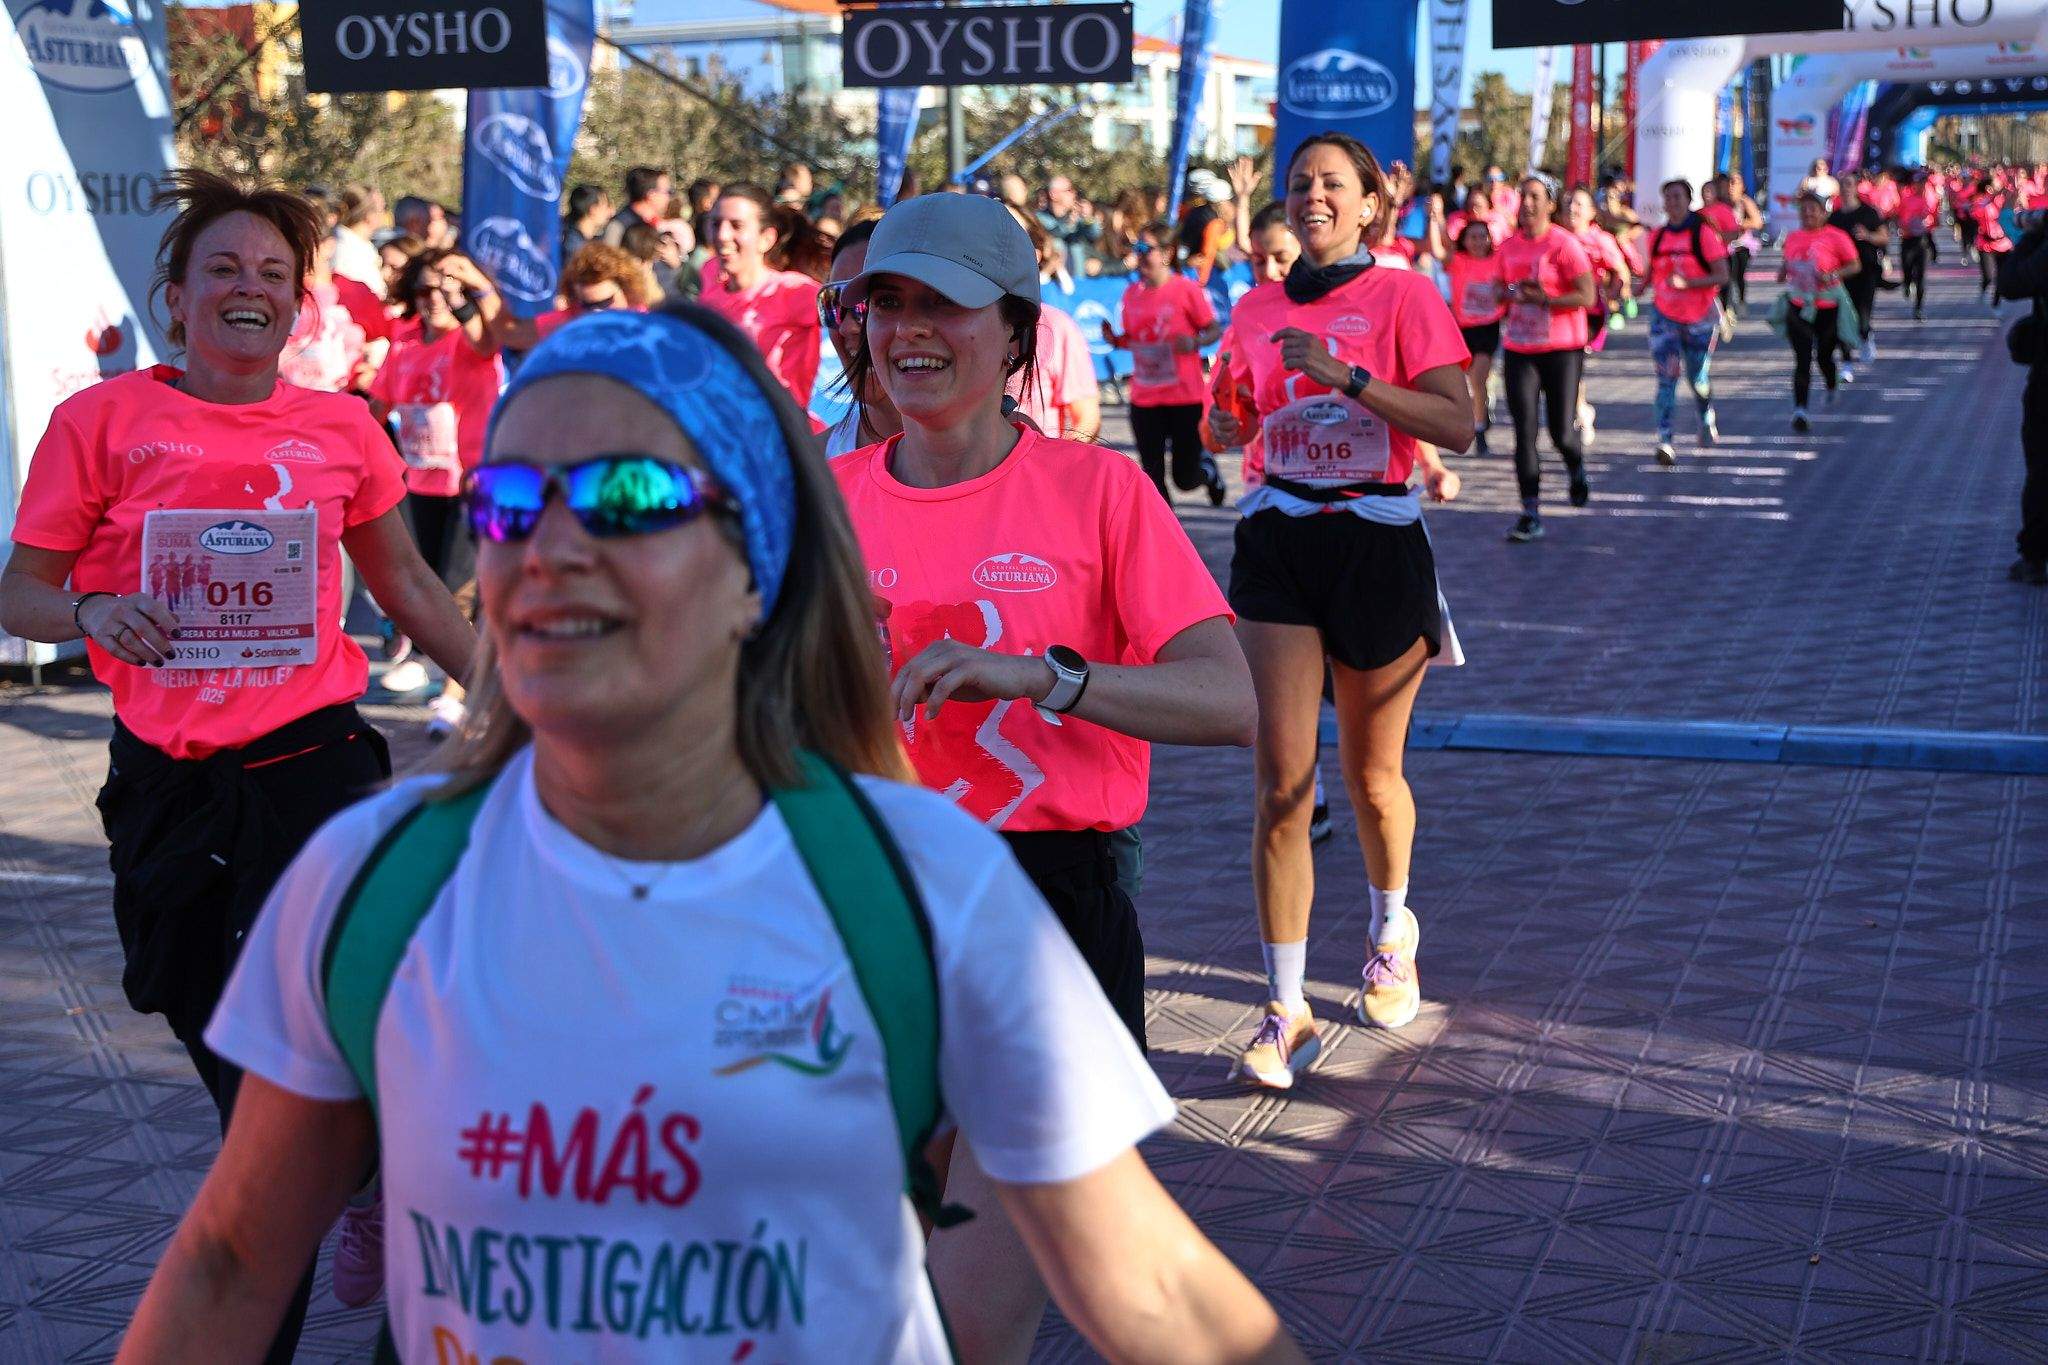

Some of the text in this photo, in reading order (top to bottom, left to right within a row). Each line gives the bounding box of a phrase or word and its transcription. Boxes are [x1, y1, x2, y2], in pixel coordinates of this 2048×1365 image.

[335, 7, 511, 60] OYSHO
[854, 12, 1121, 79] OYSHO
[26, 170, 160, 217] OYSHO
[128, 440, 205, 465] OYSHO
[1307, 442, 1351, 461] 016
[204, 532, 270, 547] ASTURIANA
[979, 566, 1051, 584] ASTURIANA
[206, 581, 274, 607] 016
[219, 614, 252, 626] 8117
[267, 628, 300, 638] VALENCIA
[175, 647, 302, 659] YSHO Santander
[458, 1083, 702, 1208] #MÁS
